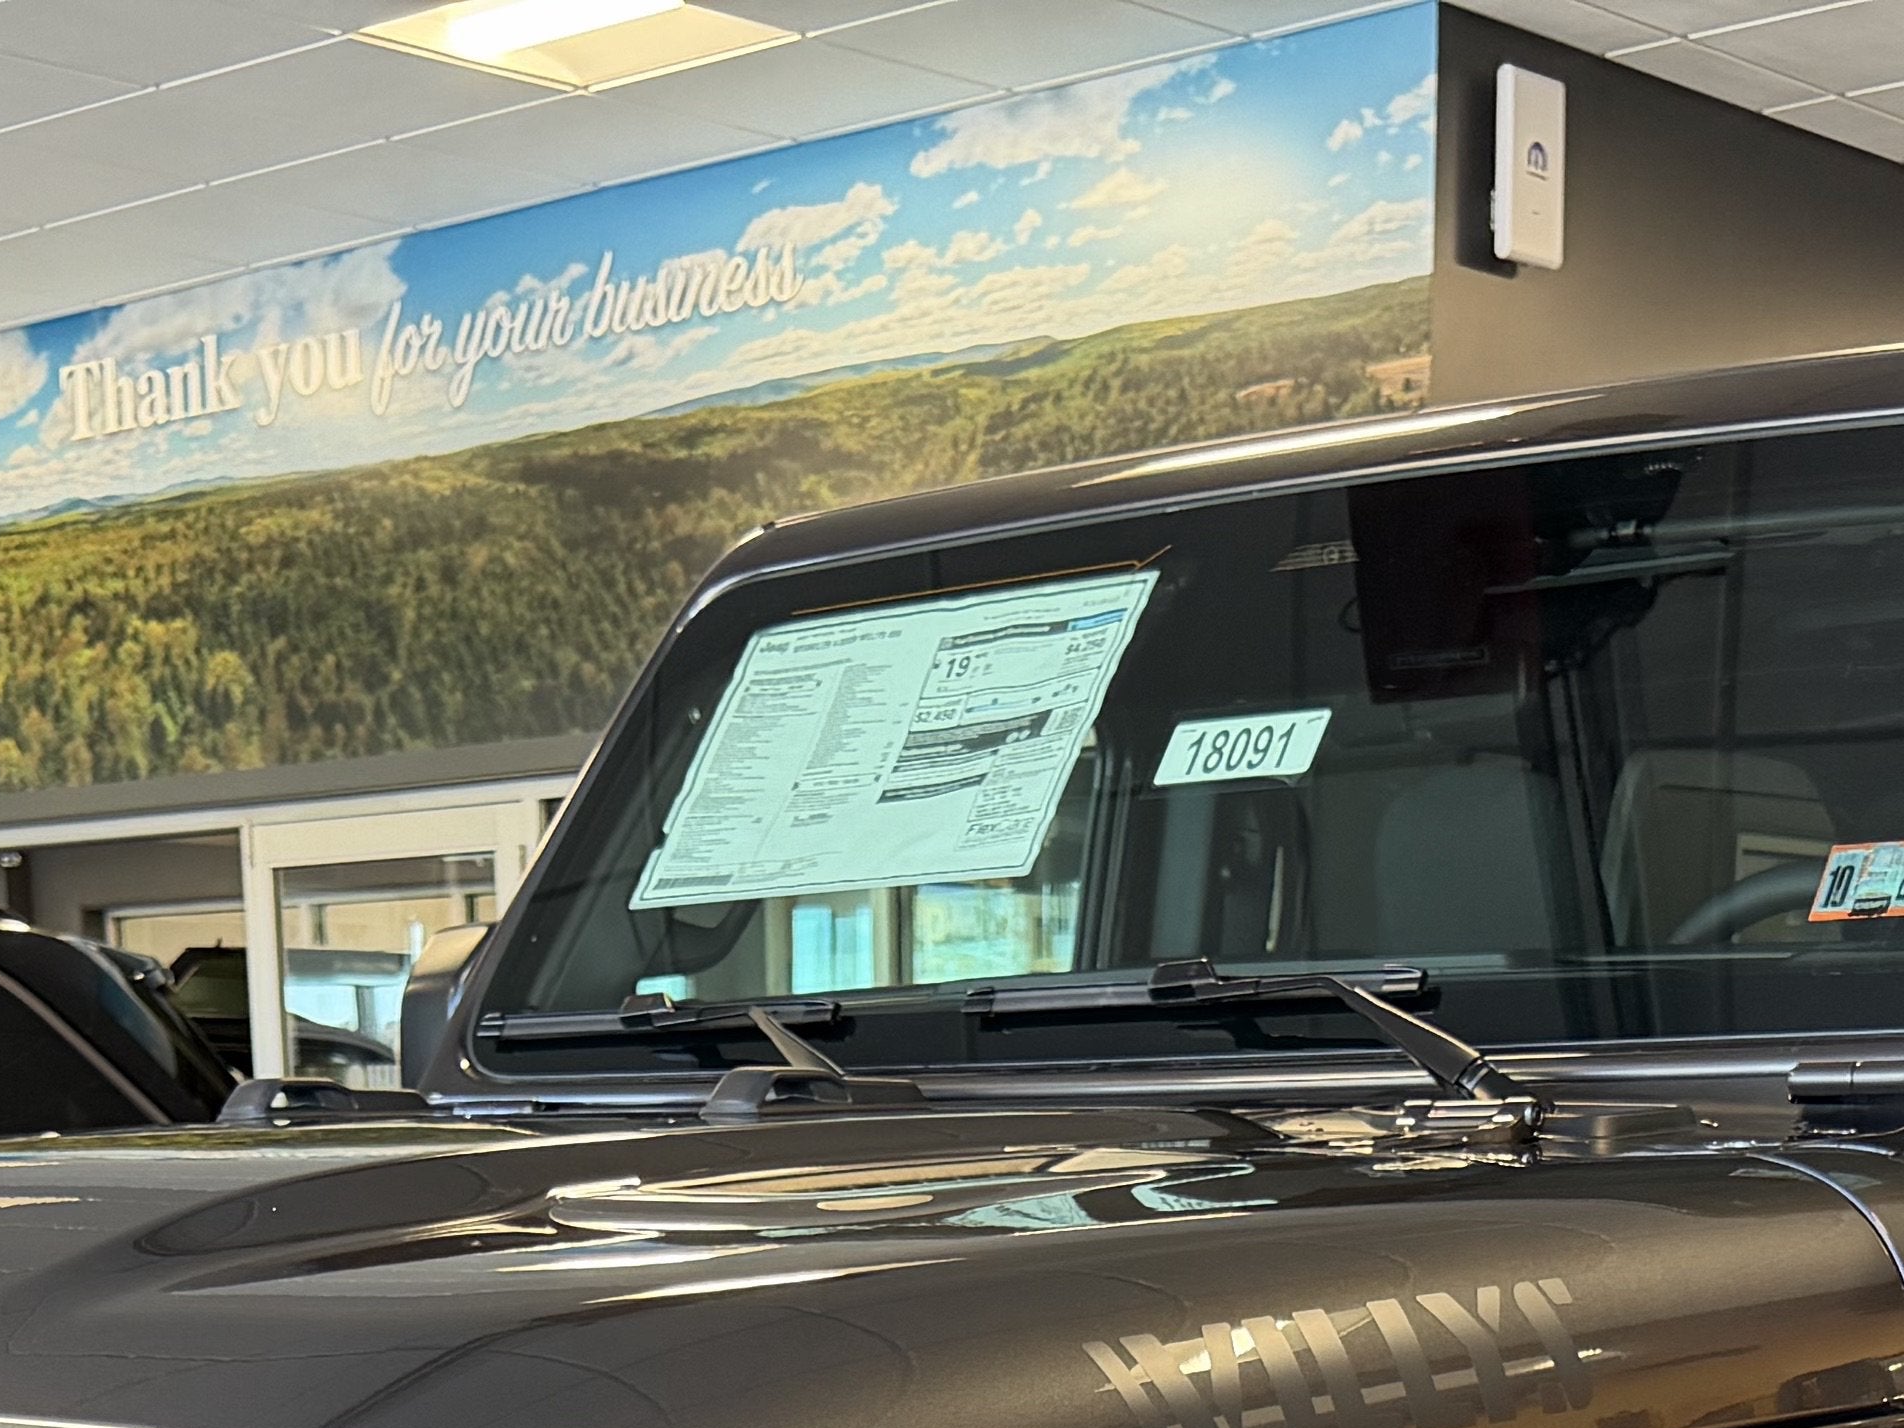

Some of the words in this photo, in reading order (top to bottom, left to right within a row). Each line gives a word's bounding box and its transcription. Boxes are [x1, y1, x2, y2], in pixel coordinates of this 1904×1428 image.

[58, 333, 241, 441] Thank
[257, 328, 365, 426] you
[371, 299, 449, 415] for
[451, 288, 576, 409] your
[585, 240, 804, 339] business
[946, 655, 971, 679] 19
[1185, 722, 1297, 776] 18091
